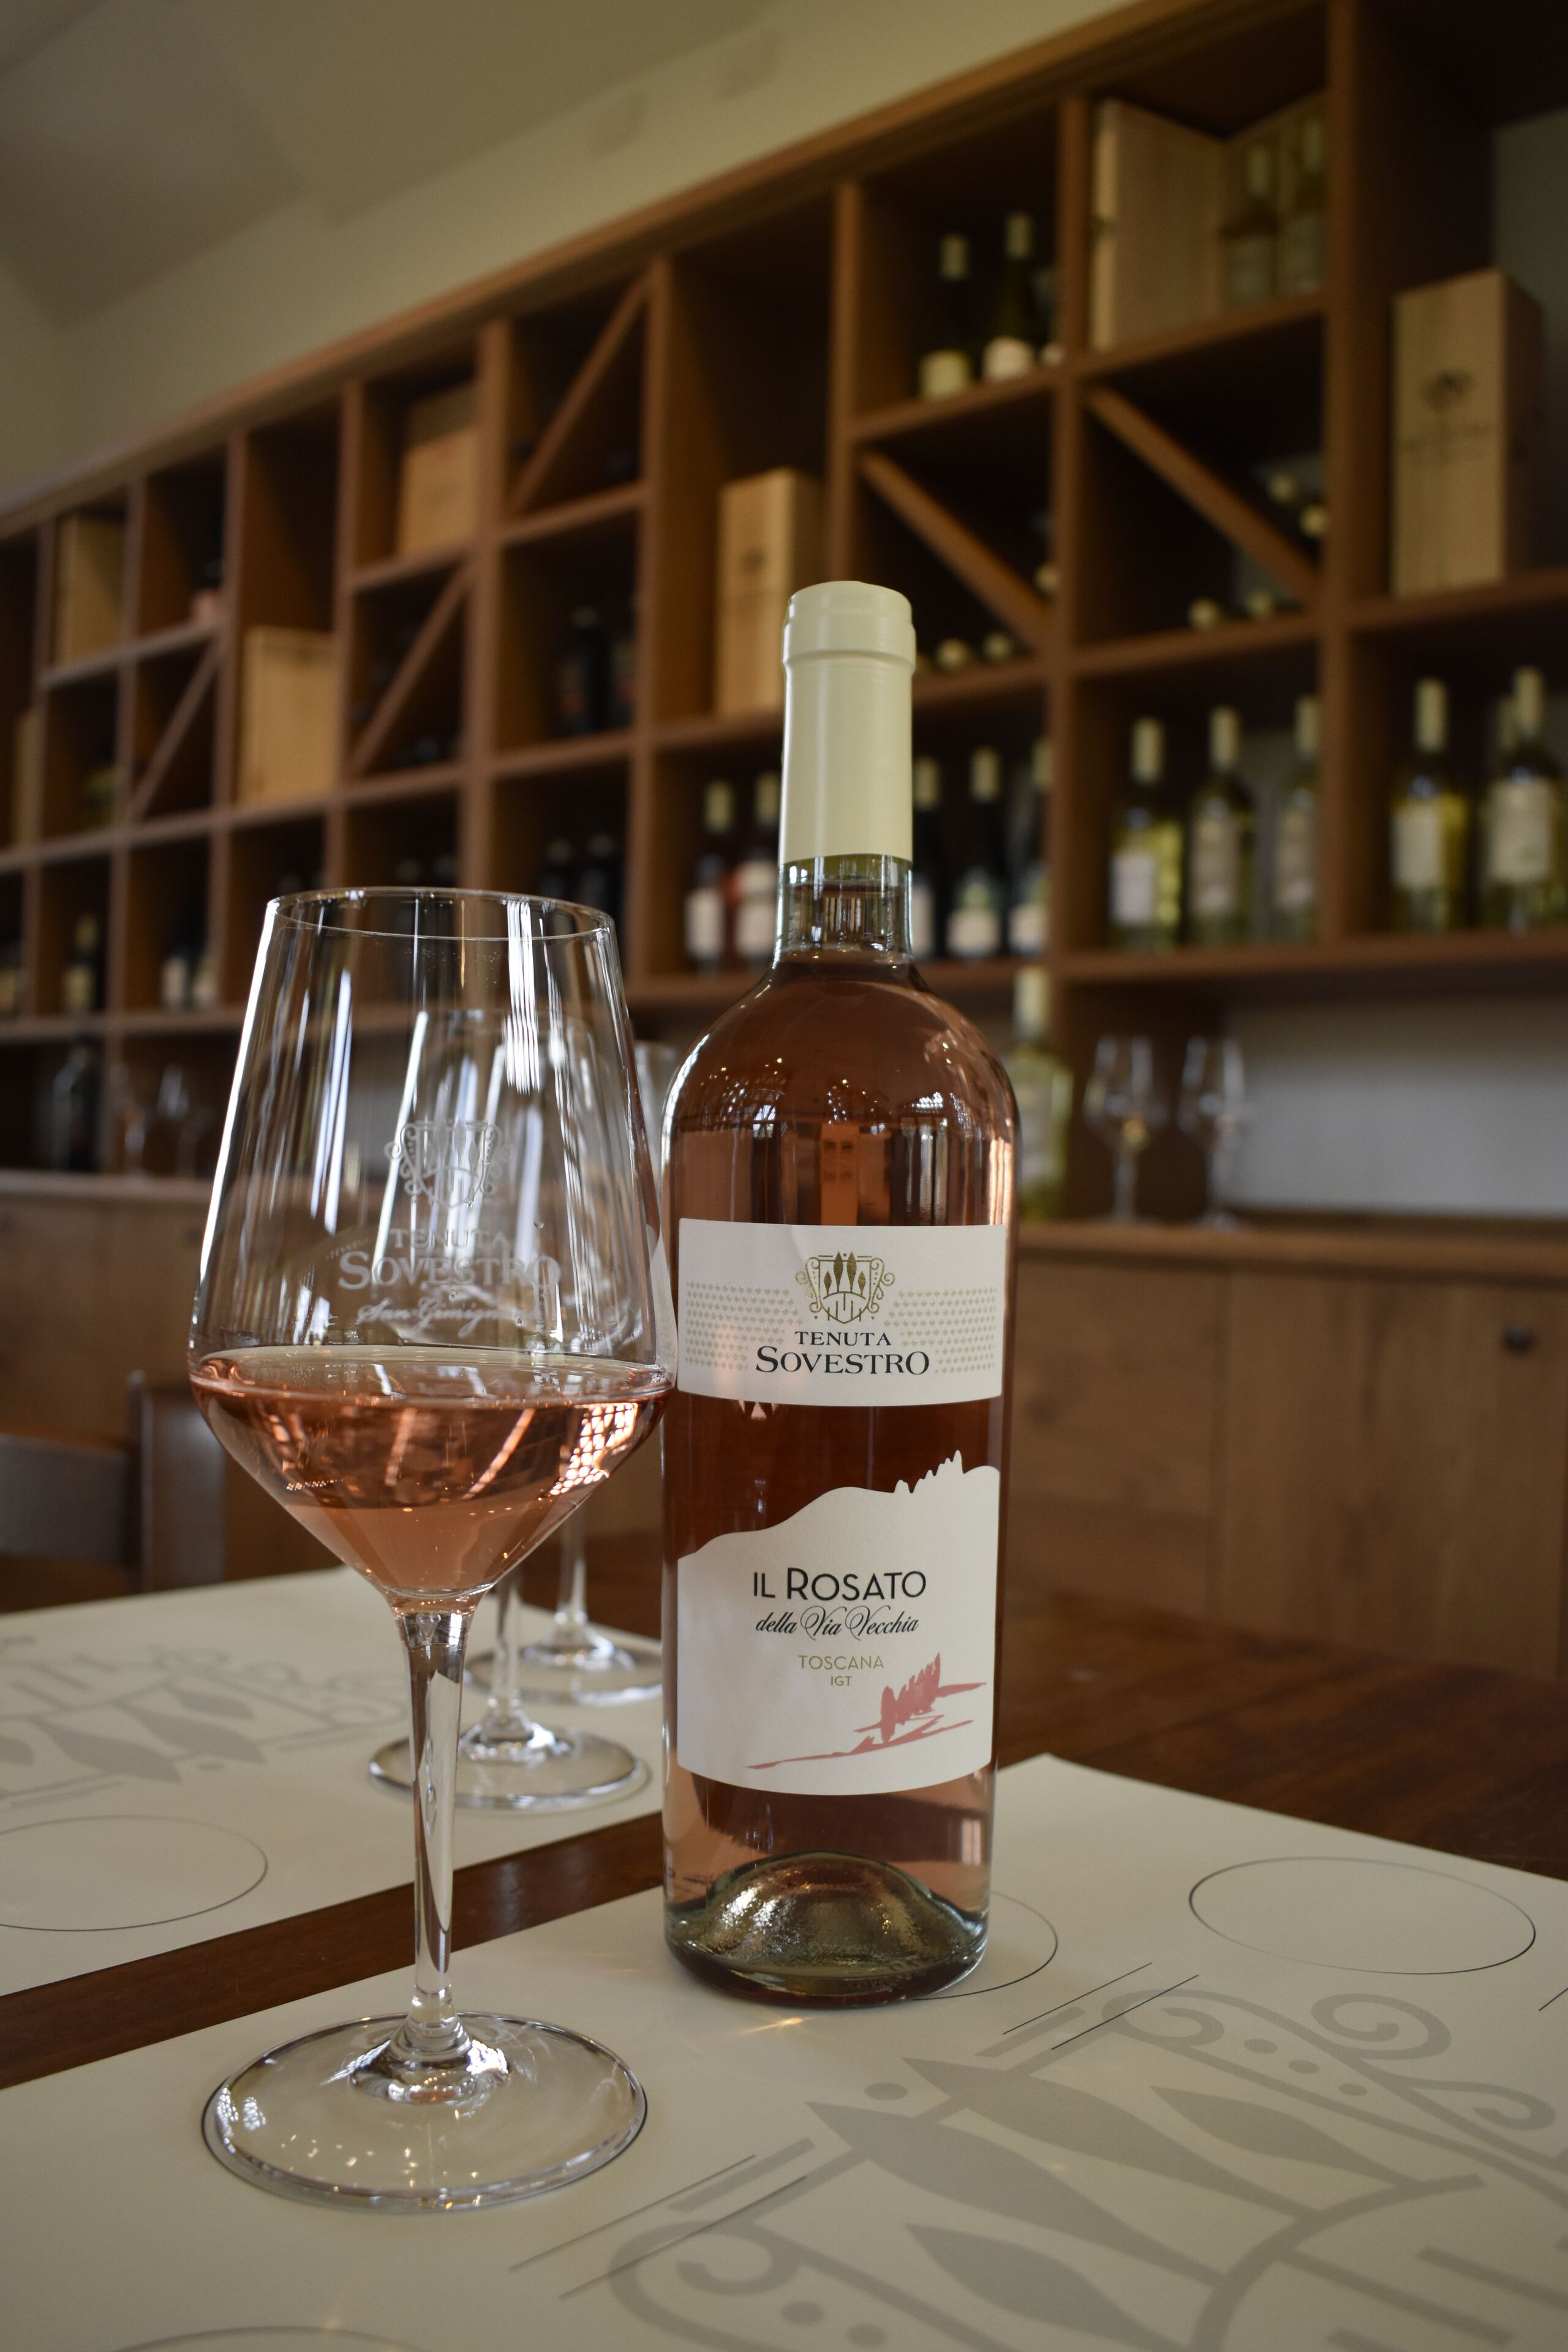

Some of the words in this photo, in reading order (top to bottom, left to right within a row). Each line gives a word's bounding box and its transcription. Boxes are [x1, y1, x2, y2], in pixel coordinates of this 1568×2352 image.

[388, 1227, 511, 1250] TENUTA
[338, 1250, 562, 1290] SOVESTRO
[794, 1331, 891, 1346] TENUTA
[755, 1346, 930, 1375] SOVESTRO
[753, 1572, 775, 1598] IL
[787, 1567, 926, 1601] ROSATO
[755, 1611, 797, 1634] della
[800, 1605, 847, 1641] Via
[845, 1605, 919, 1641] Vecchia
[798, 1655, 884, 1670] TOSCANA
[830, 1676, 852, 1686] IGT
